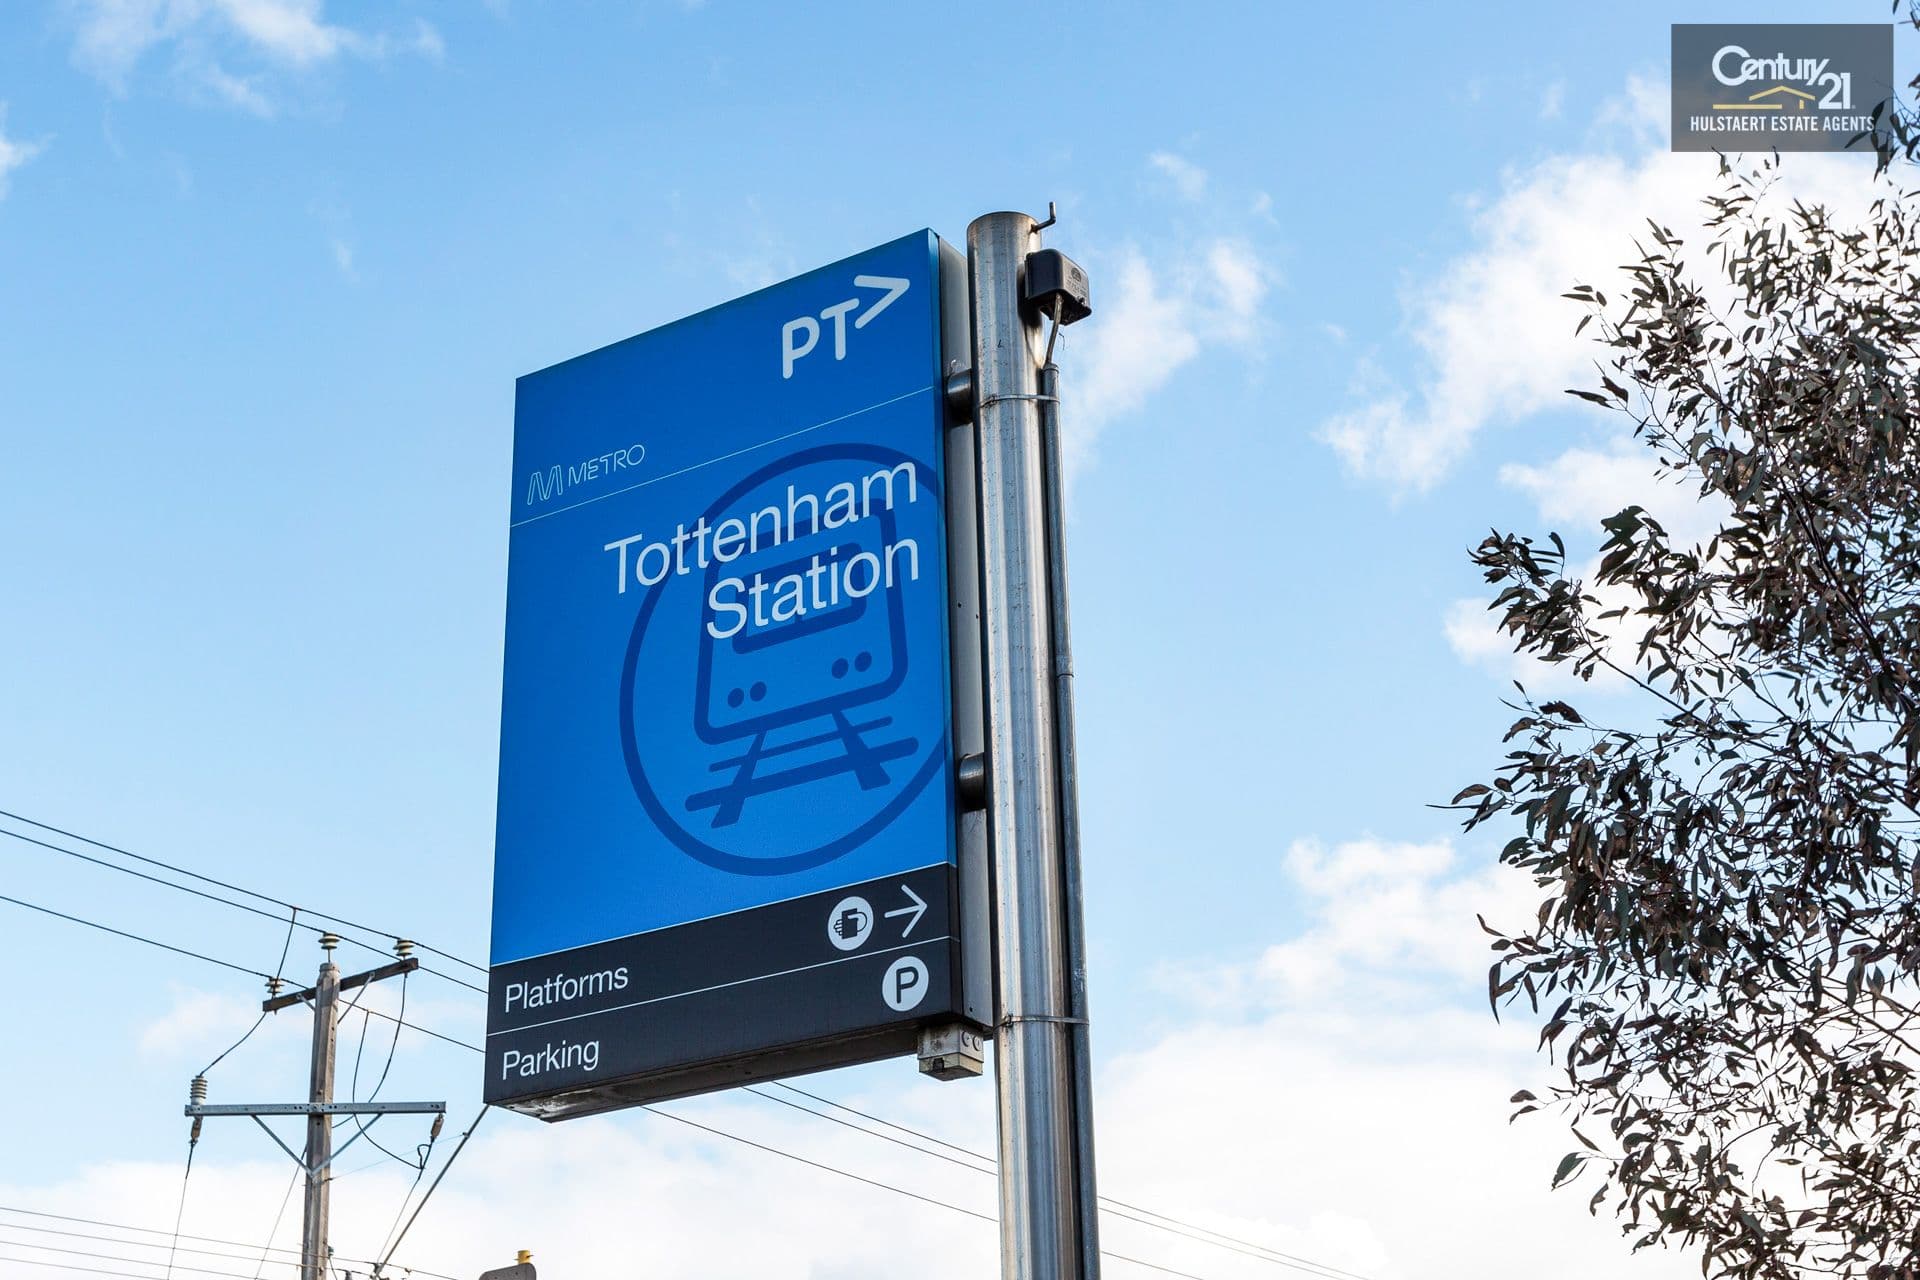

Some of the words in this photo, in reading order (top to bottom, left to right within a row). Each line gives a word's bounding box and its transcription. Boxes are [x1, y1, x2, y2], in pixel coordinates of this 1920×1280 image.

[568, 444, 646, 487] METRO
[604, 461, 917, 594] Tottenham
[706, 538, 919, 640] Station
[505, 964, 629, 1013] Platforms
[501, 1038, 600, 1080] Parking
